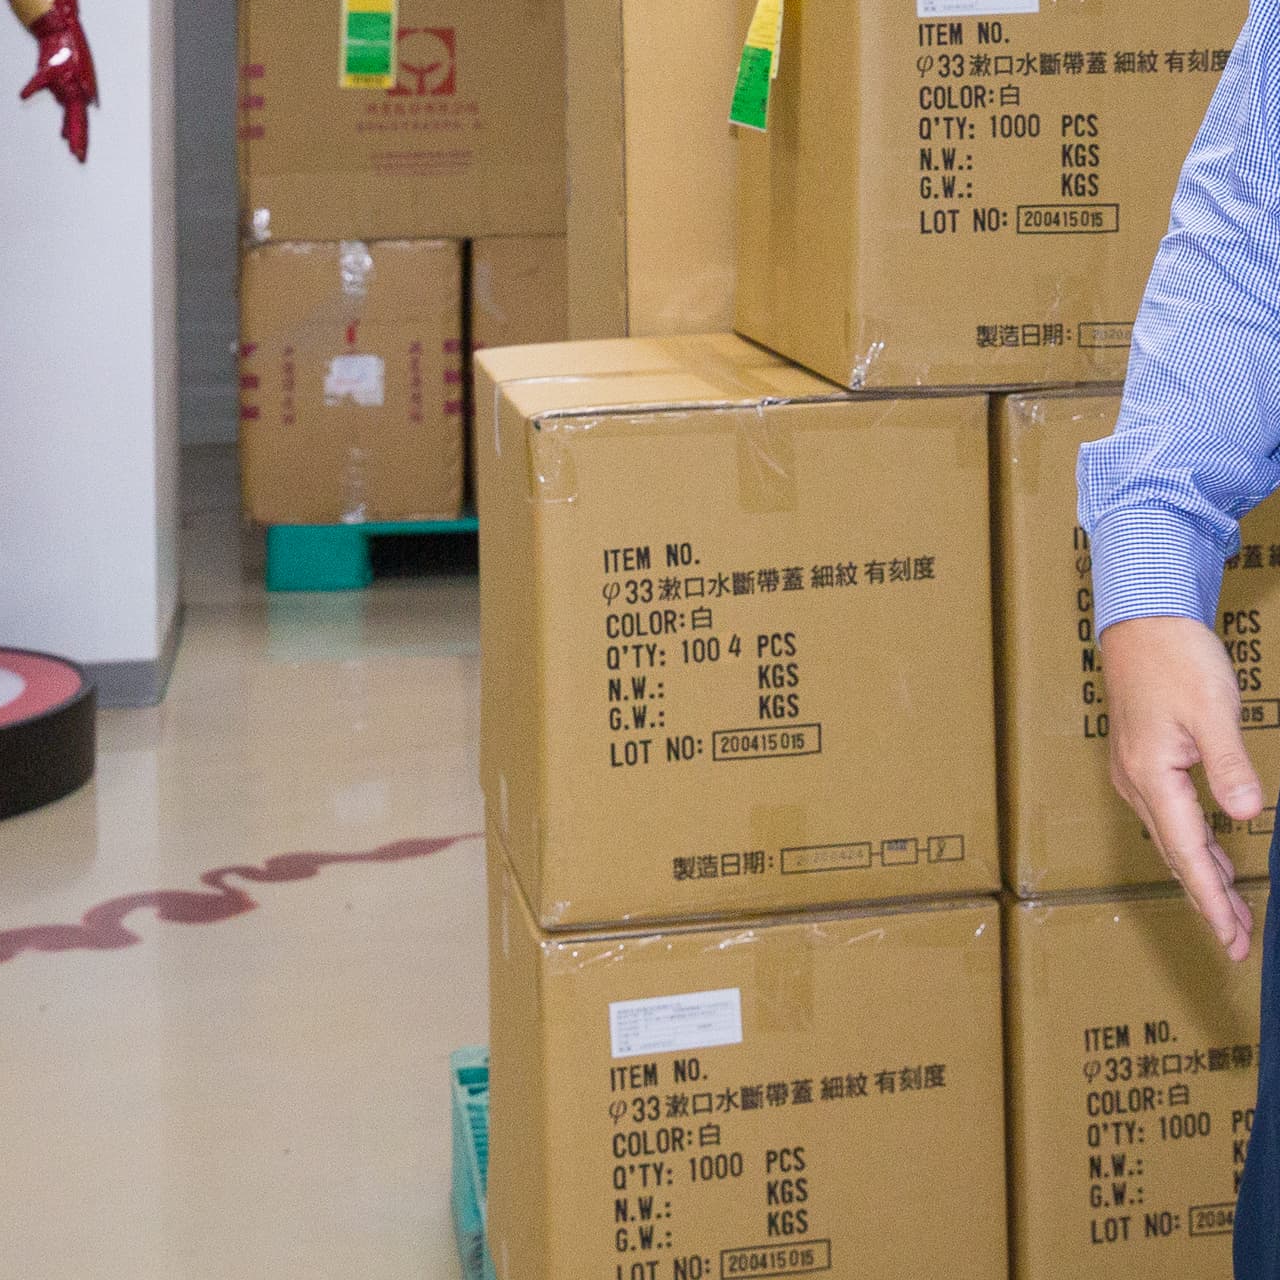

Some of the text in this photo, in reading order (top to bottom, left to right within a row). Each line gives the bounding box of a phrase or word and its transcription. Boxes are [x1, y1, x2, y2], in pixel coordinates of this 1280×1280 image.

[918, 21, 1011, 47] ITEM NO.
[989, 114, 1041, 138] 1000
[1061, 114, 1099, 138] PCS
[919, 144, 1100, 171] N.W.: KGS
[919, 173, 1100, 199] G.W.: KGS
[919, 210, 961, 234] LOT
[973, 208, 1009, 232] NO:
[604, 542, 701, 573] ITEM NO.
[864, 555, 936, 585] 有刻度
[1223, 610, 1261, 636] PCS
[757, 632, 797, 659] PCS
[608, 663, 799, 702] N.W.: KGS
[1236, 667, 1262, 692] GS
[609, 693, 800, 732] G.W.: KGS
[1084, 715, 1109, 738] LO
[610, 739, 652, 768] LOT
[666, 735, 704, 763] NO:
[1084, 1020, 1178, 1052] ITEM NO.
[610, 1057, 709, 1092] ITEM NO.
[1159, 1111, 1211, 1141] 1000
[687, 1152, 744, 1182] 1000
[765, 1146, 806, 1174] PCS
[614, 1179, 808, 1224] N.W.: KGS
[614, 1209, 809, 1253] G.W.: KGS
[1091, 1216, 1131, 1245] LOT
[1144, 1211, 1181, 1238] NO:
[673, 1255, 711, 1280] NO:
